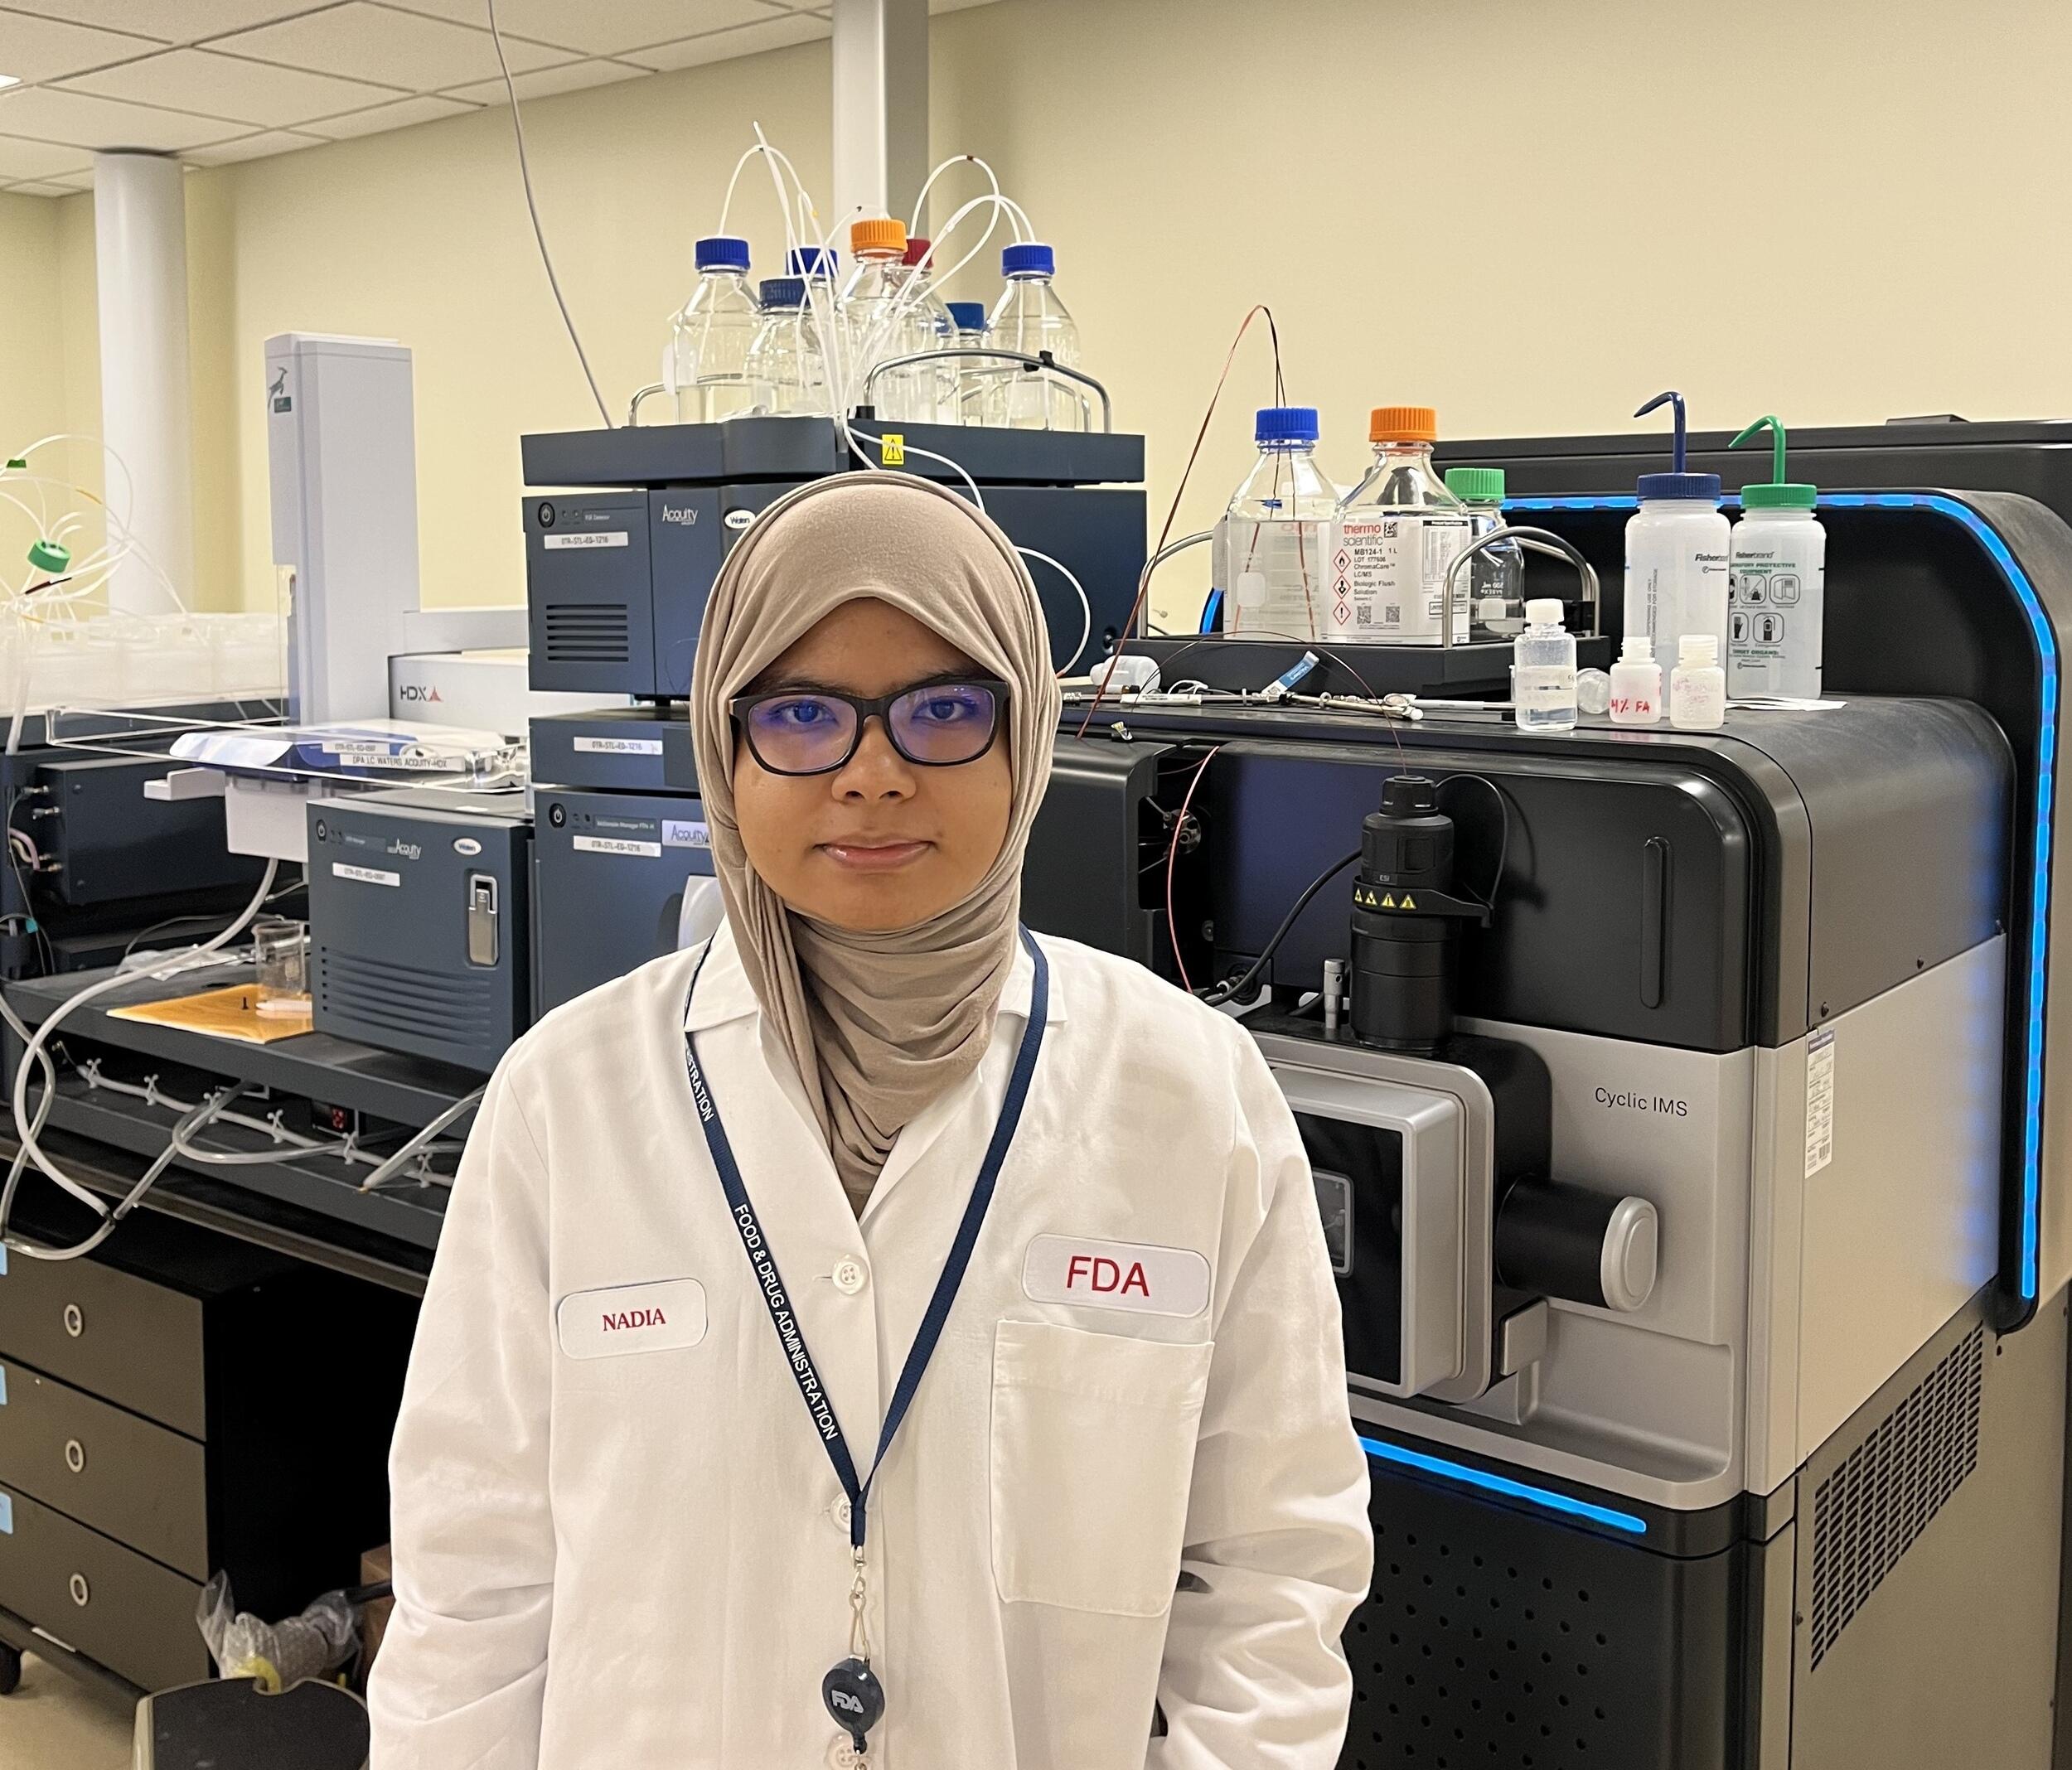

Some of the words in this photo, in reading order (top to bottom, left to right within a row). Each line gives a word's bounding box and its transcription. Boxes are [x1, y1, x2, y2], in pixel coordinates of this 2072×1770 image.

[1343, 524, 1381, 534] thermo
[1343, 534, 1383, 546] scientific
[400, 684, 427, 702] HDX
[1635, 700, 1650, 713] FA
[378, 757, 402, 767] WATERS
[1595, 1086, 1648, 1109] Cyclic
[1653, 1095, 1687, 1117] IMS
[734, 1203, 761, 1249] FOOD
[753, 1250, 767, 1263] &
[758, 1260, 785, 1308] DRUG
[1066, 1255, 1150, 1298] FDA
[602, 1308, 666, 1331] NADIA
[774, 1309, 839, 1441] ADMINISTRATION
[831, 1690, 864, 1714] FDA
